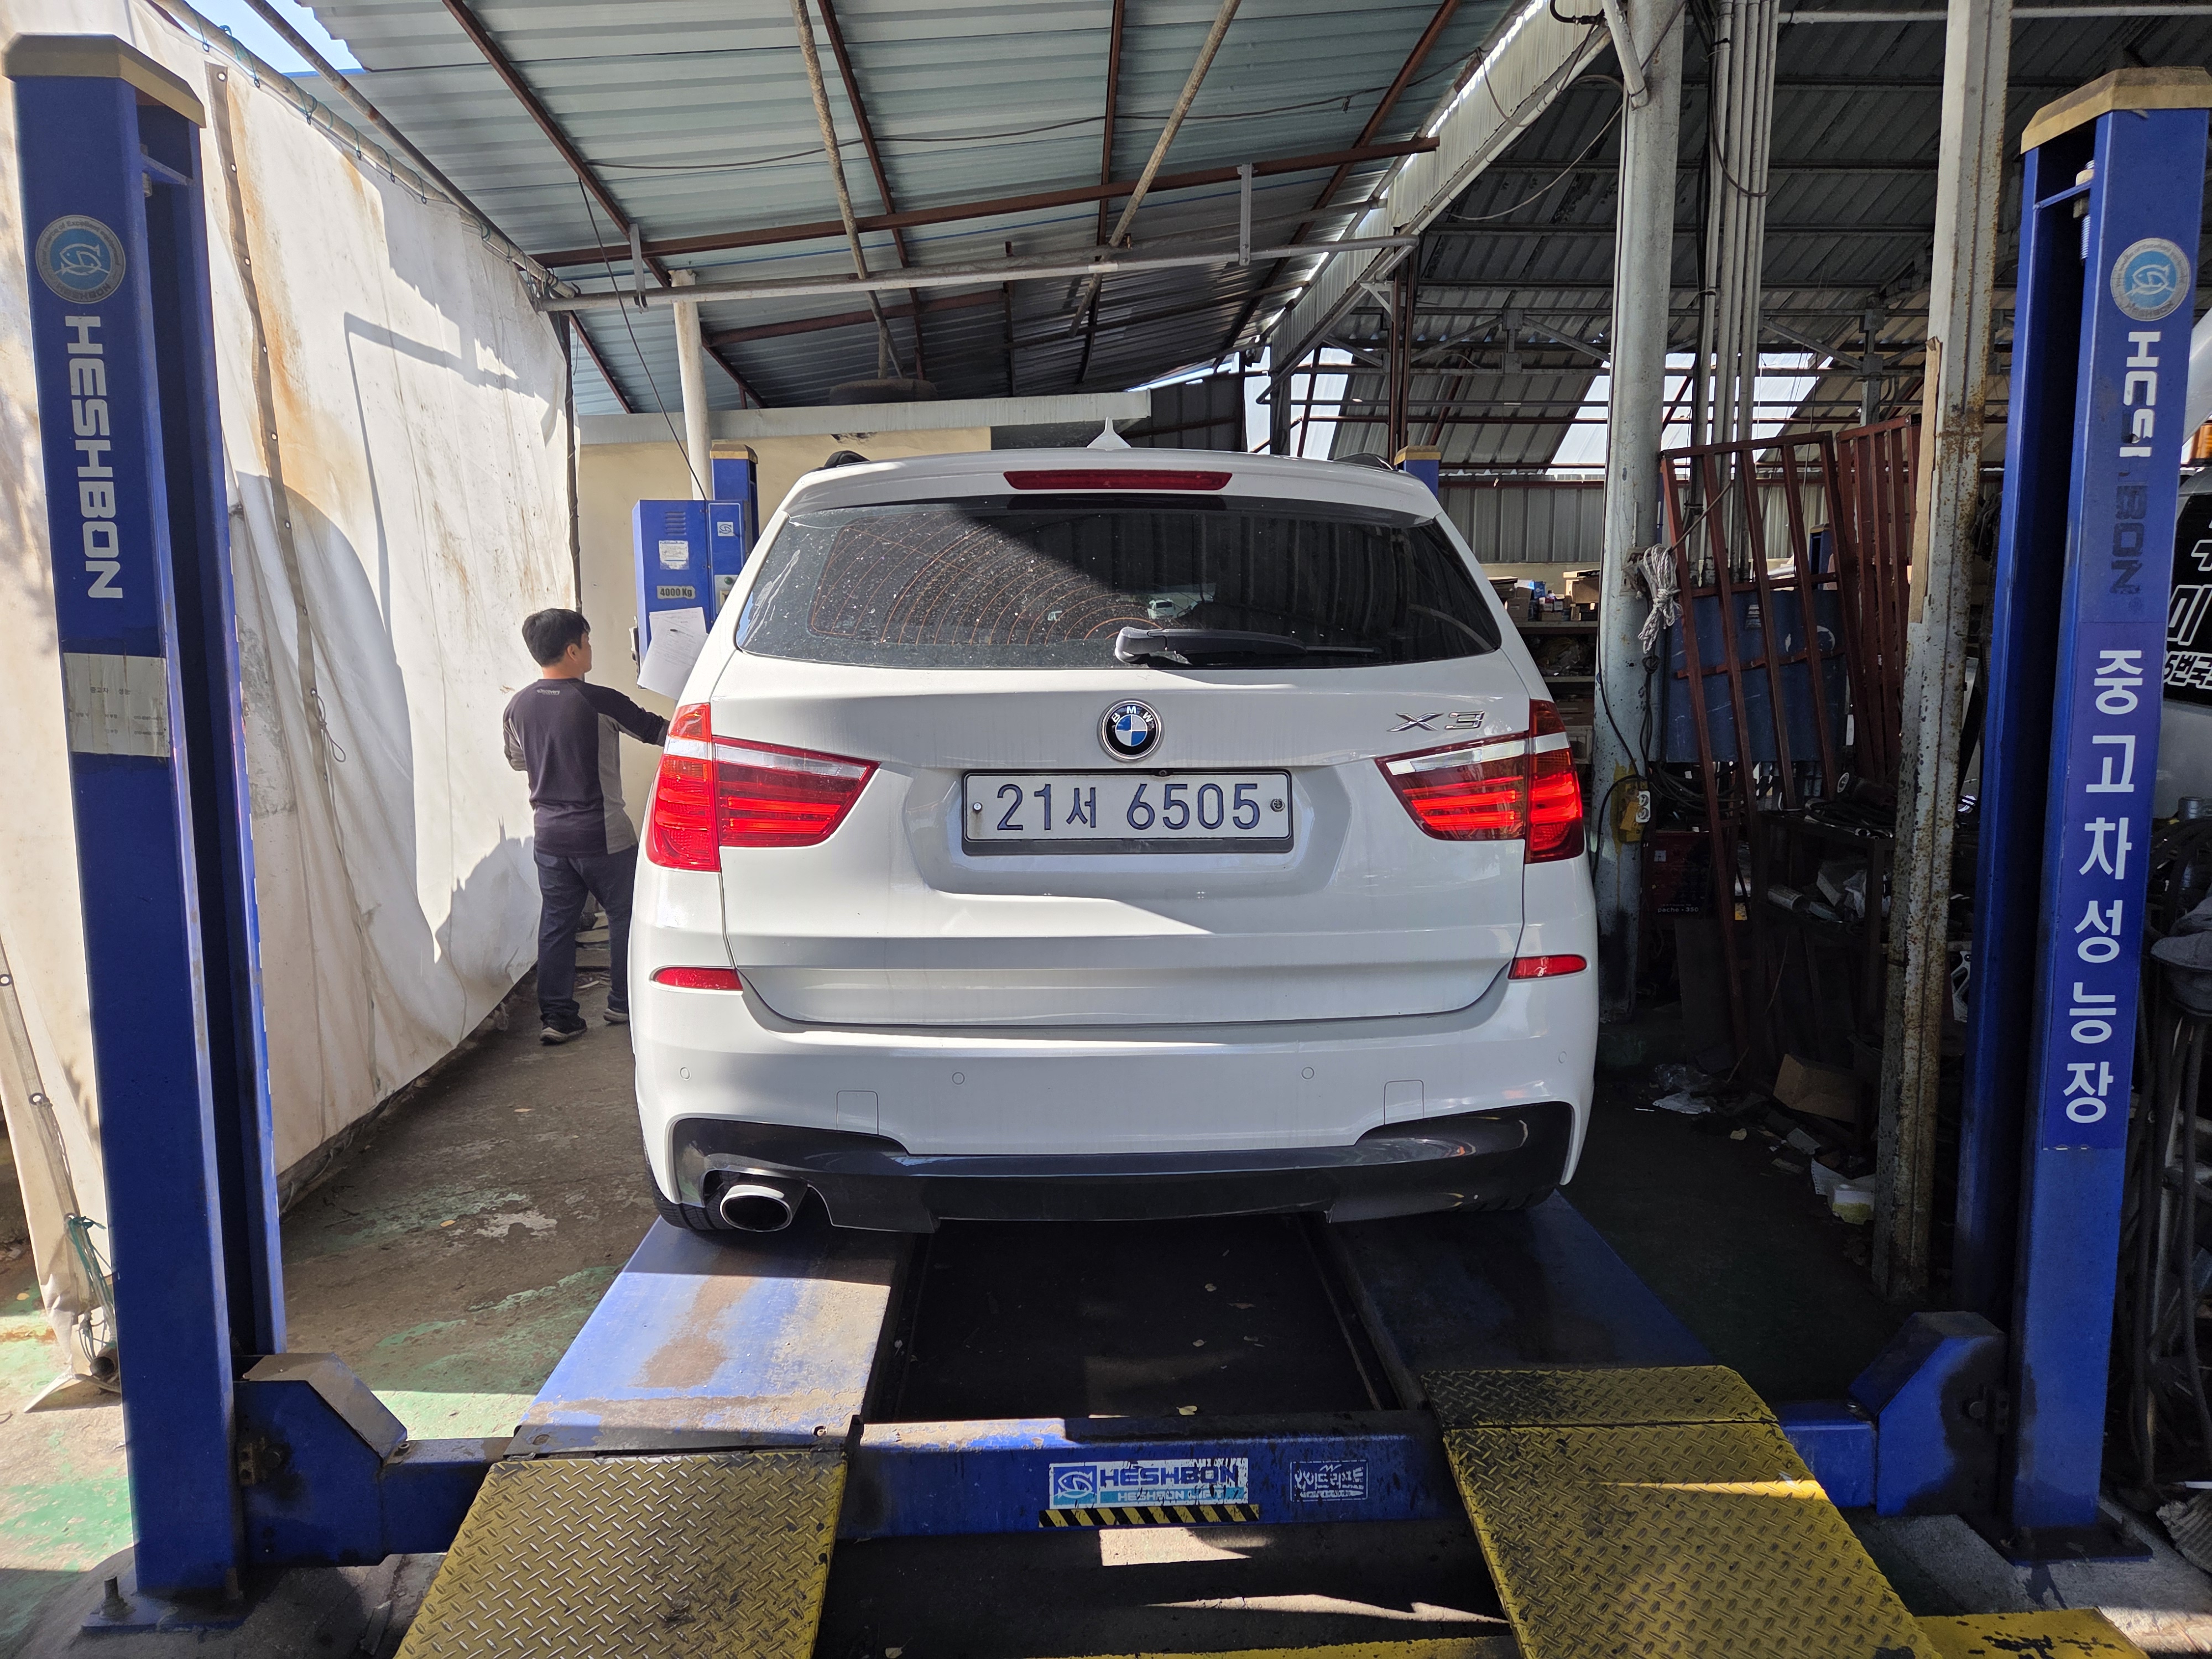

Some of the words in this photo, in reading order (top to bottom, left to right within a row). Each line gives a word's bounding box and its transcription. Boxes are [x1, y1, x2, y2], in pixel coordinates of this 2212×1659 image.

[65, 316, 123, 599] HESHBON
[660, 587, 681, 597] 4000
[682, 587, 693, 598] Kg
[1111, 705, 1154, 723] BMW
[1387, 710, 1485, 732] X3
[997, 783, 1097, 831] 21서
[1126, 782, 1261, 830] 6505
[1100, 1465, 1238, 1488] HESHBON
